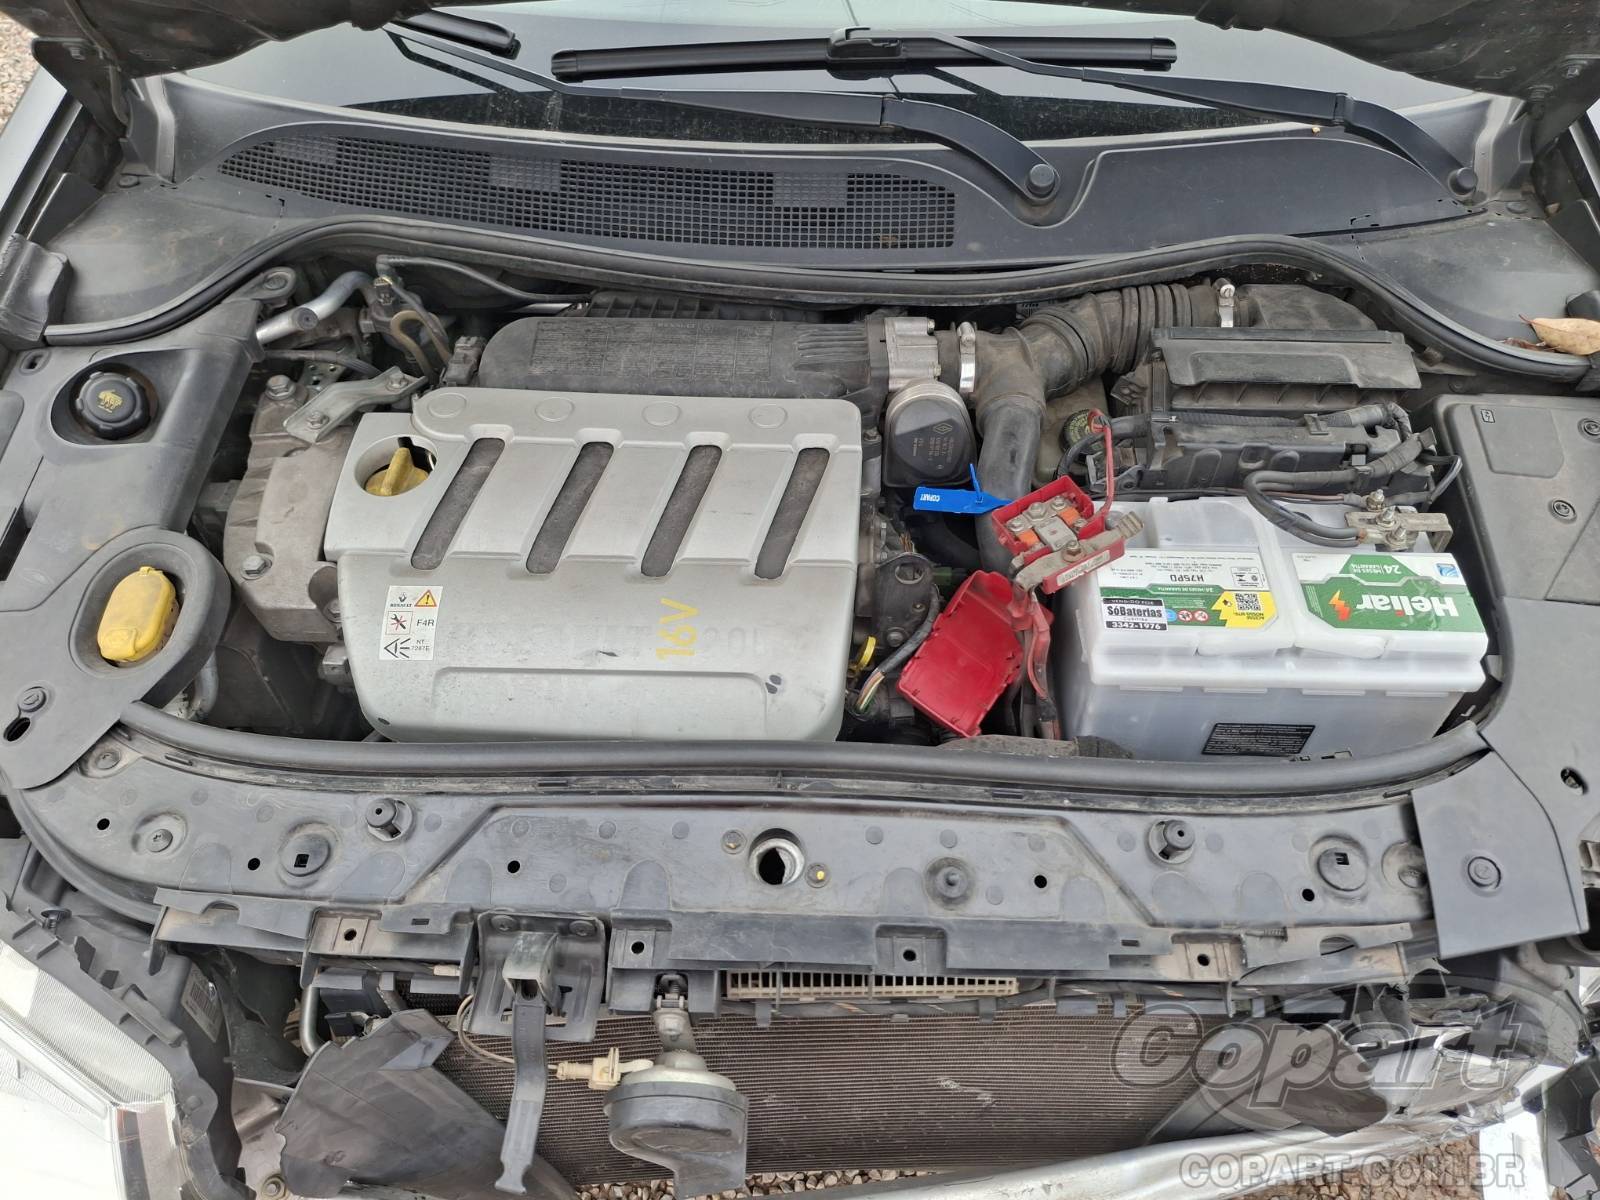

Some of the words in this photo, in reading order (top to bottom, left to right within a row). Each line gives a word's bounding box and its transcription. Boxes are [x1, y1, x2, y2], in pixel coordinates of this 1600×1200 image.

[920, 493, 941, 502] COPART
[1383, 564, 1402, 574] 24
[1170, 574, 1204, 582] H75PD
[1356, 594, 1459, 617] Heliar
[1107, 605, 1162, 617] SóBaterias
[416, 619, 435, 627] F4R
[1111, 621, 1161, 630] 3342-1976
[656, 598, 699, 660] 16V
